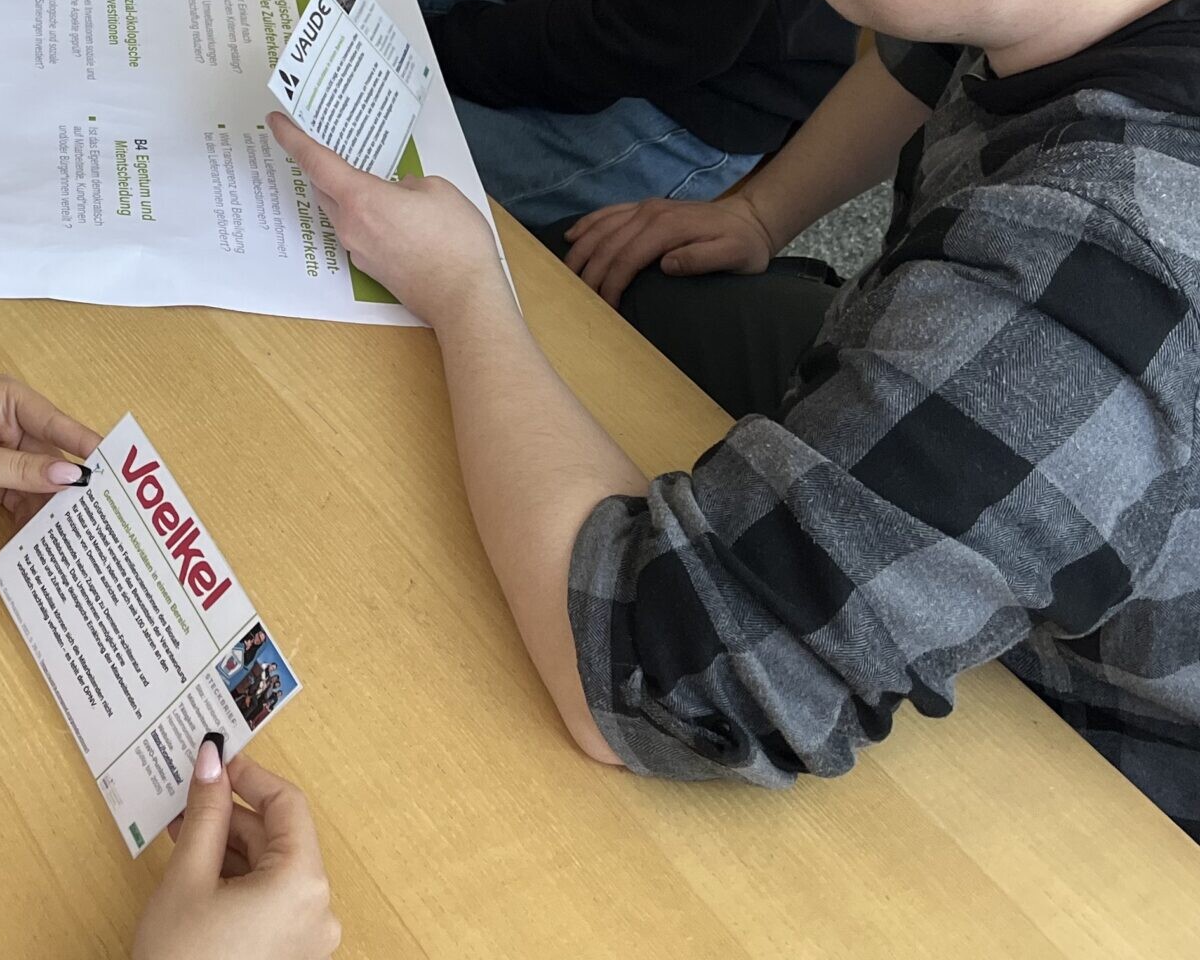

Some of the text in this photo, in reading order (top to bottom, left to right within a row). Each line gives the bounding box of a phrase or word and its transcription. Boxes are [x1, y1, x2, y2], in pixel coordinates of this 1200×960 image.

[262, 11, 281, 69] Zulieferkette
[115, 140, 132, 216] Mitentscheidung
[134, 139, 155, 222] B4 Eigentum und
[222, 148, 235, 188] Transparenz
[291, 167, 303, 176] in
[293, 179, 305, 197] der
[228, 191, 240, 205] und
[272, 218, 288, 258] informiert
[296, 200, 318, 277] Zulieferkette
[321, 231, 340, 274] Mitent-
[95, 524, 110, 548] Voelkel
[121, 445, 232, 611] Voelkel
[69, 568, 78, 582] Das
[103, 488, 191, 636] Gemeinwohl-Aktivitäten in einem Bereich
[135, 615, 145, 629] 100
[142, 627, 157, 651] Jahren
[139, 673, 150, 688] und
